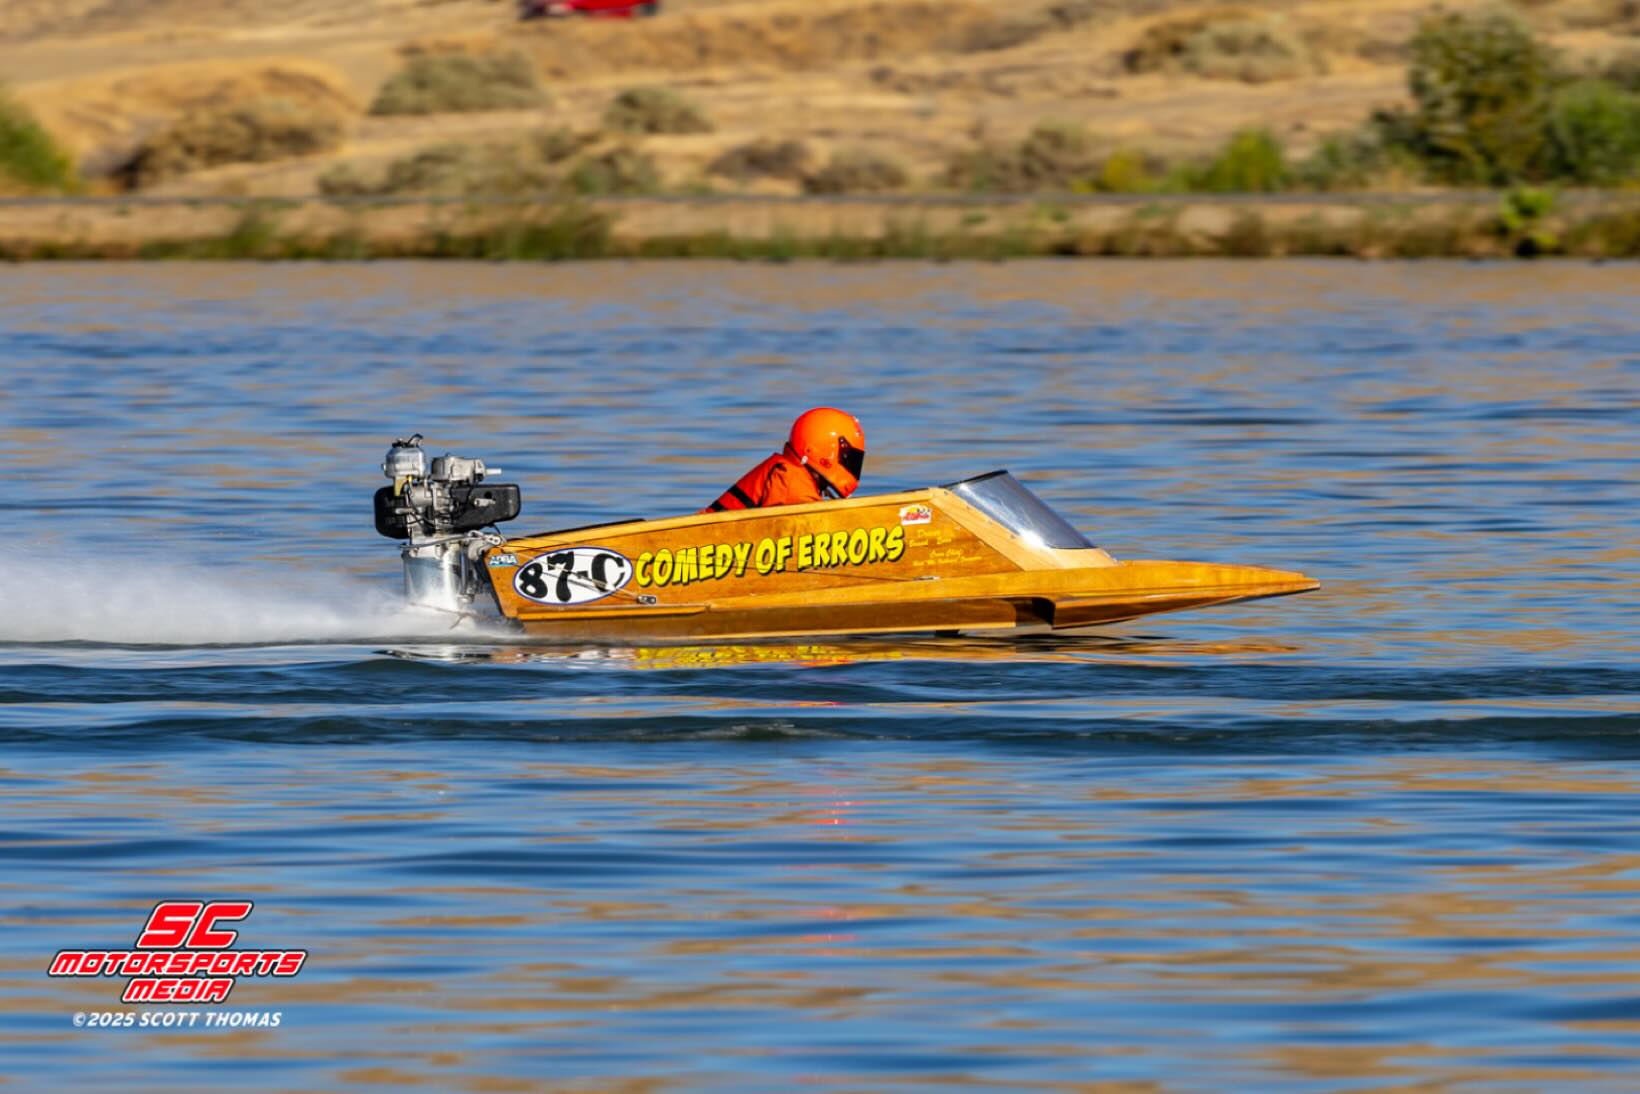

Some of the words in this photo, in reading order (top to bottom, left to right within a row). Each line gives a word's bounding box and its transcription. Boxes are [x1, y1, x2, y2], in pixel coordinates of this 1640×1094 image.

[518, 550, 626, 603] 87-C
[635, 543, 751, 587] COMEDY
[755, 535, 793, 575] OF
[797, 525, 905, 572] ERRORS
